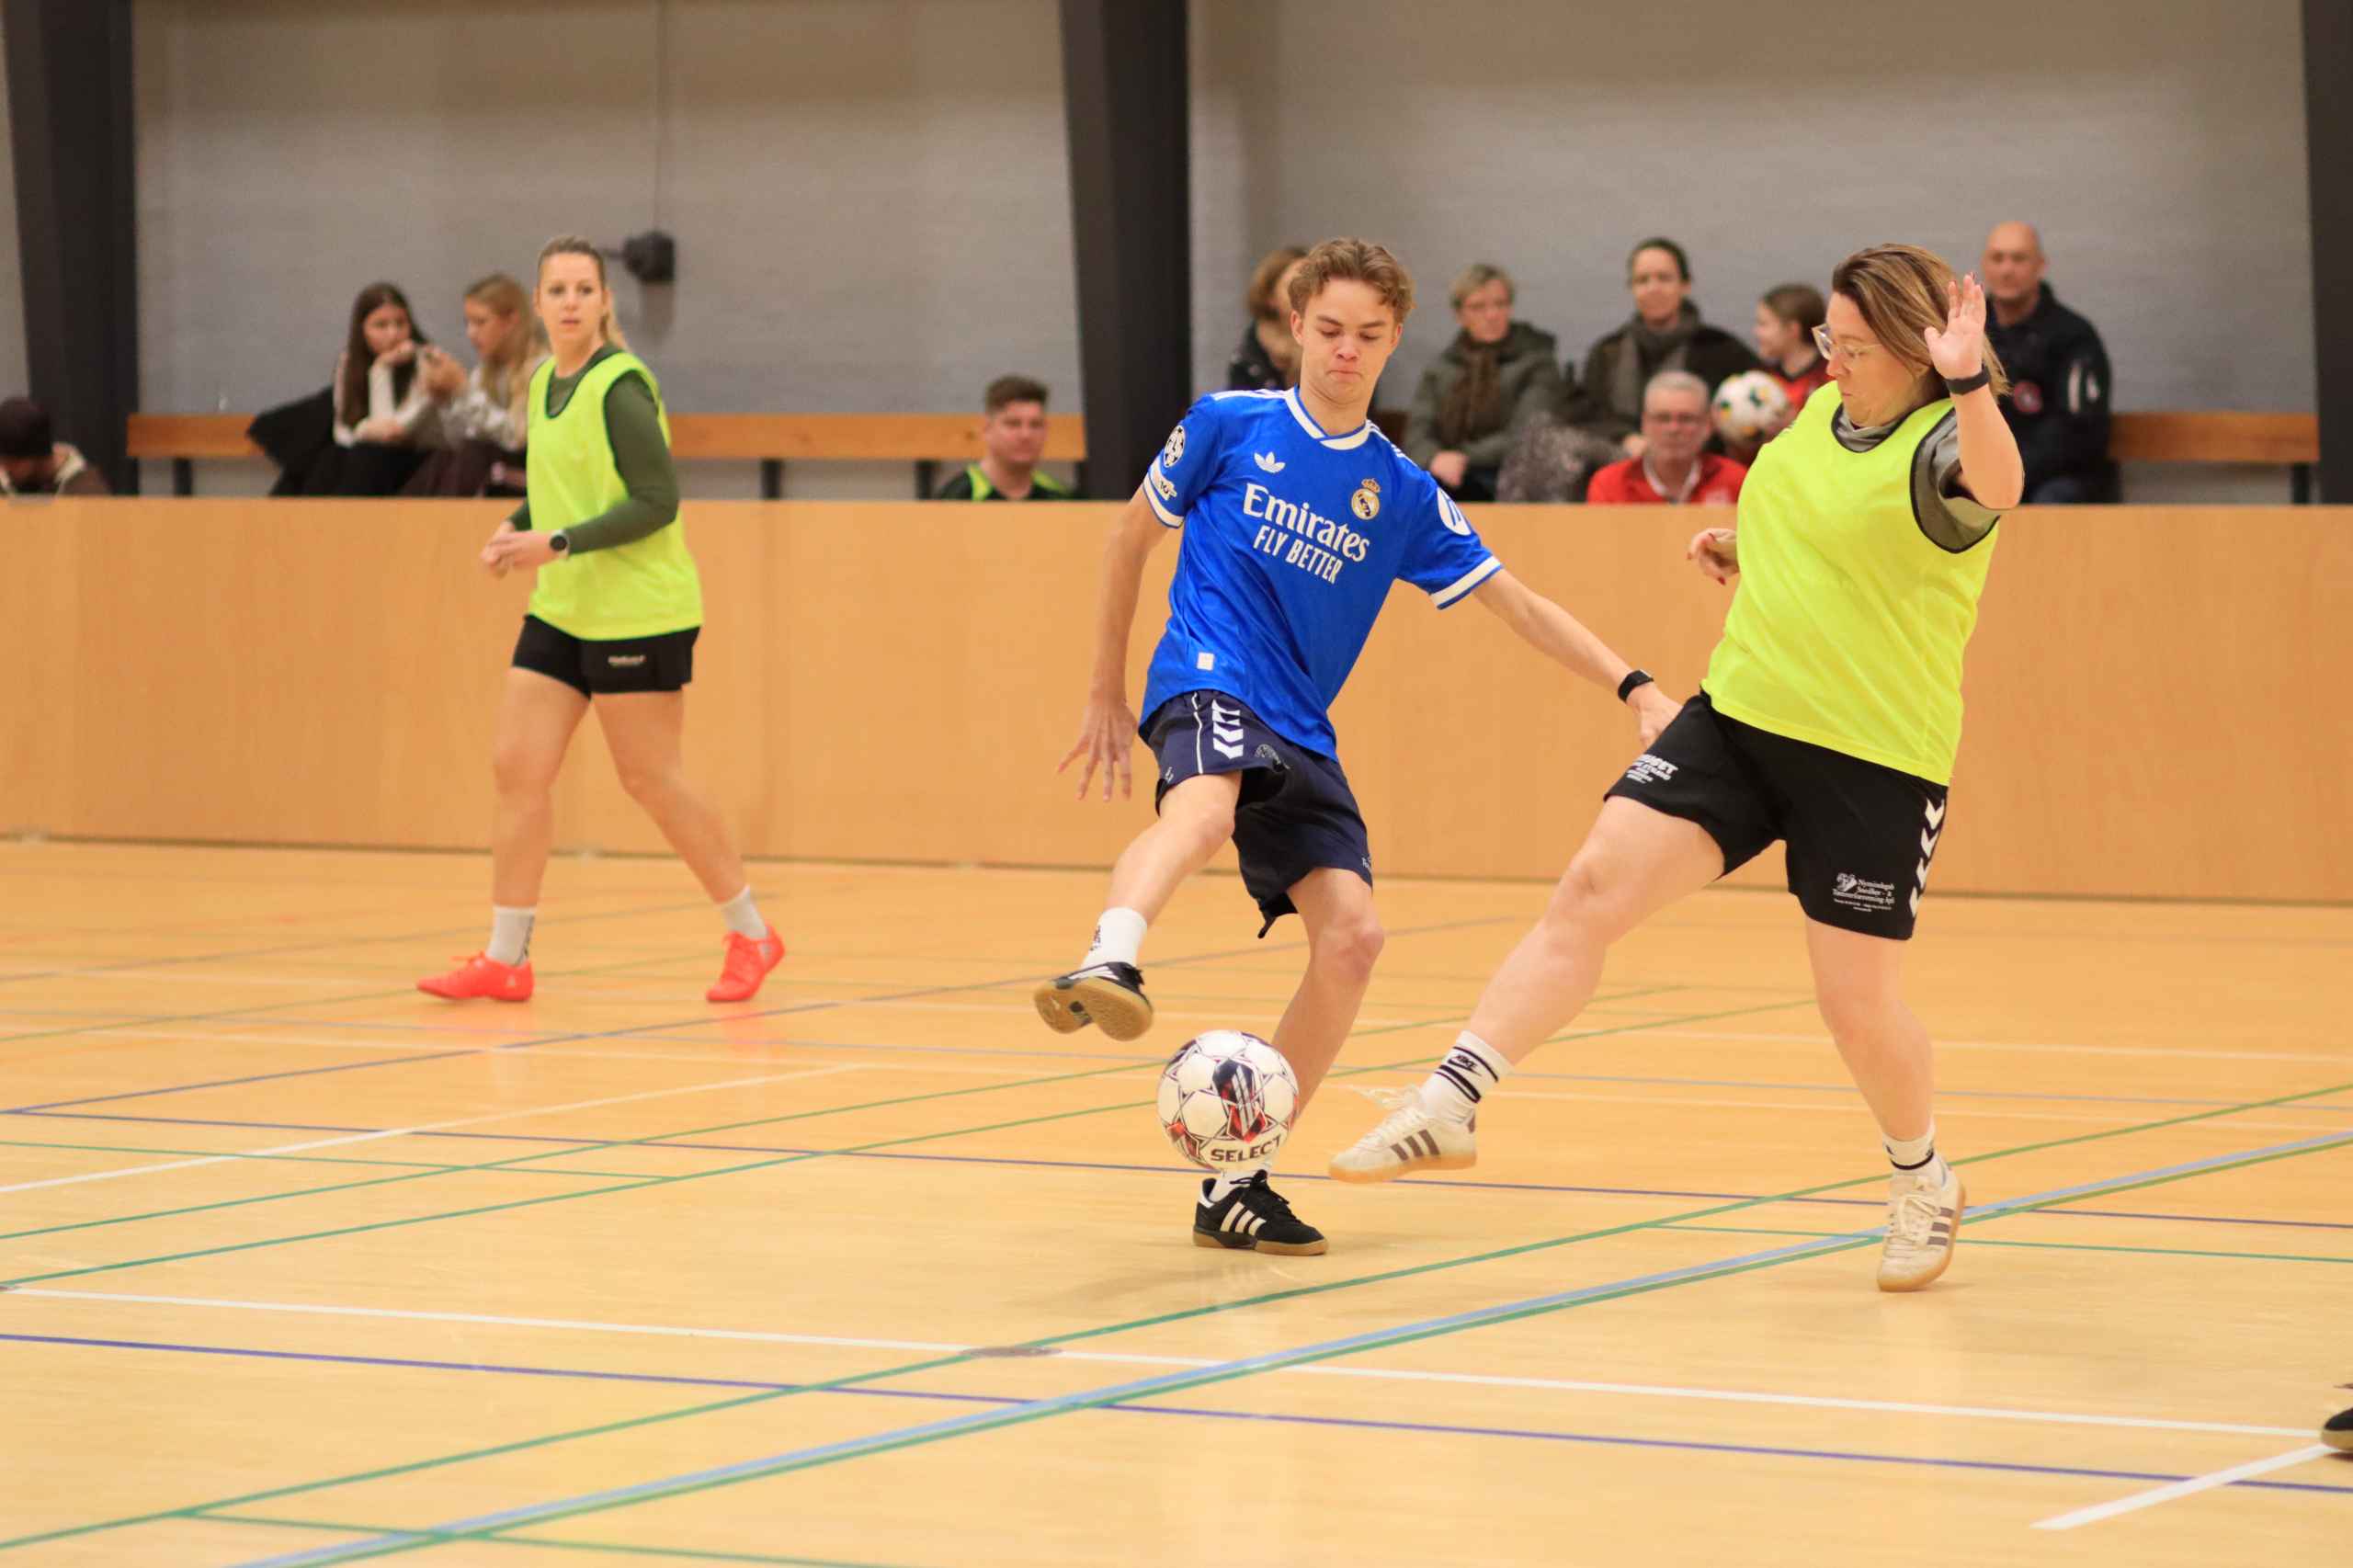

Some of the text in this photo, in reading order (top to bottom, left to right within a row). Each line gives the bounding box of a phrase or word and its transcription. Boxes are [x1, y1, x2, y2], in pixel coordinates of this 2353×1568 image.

[1243, 483, 1370, 562] Emirates
[1253, 525, 1343, 584] FLY BETTER
[1210, 1133, 1282, 1163] SELECT
